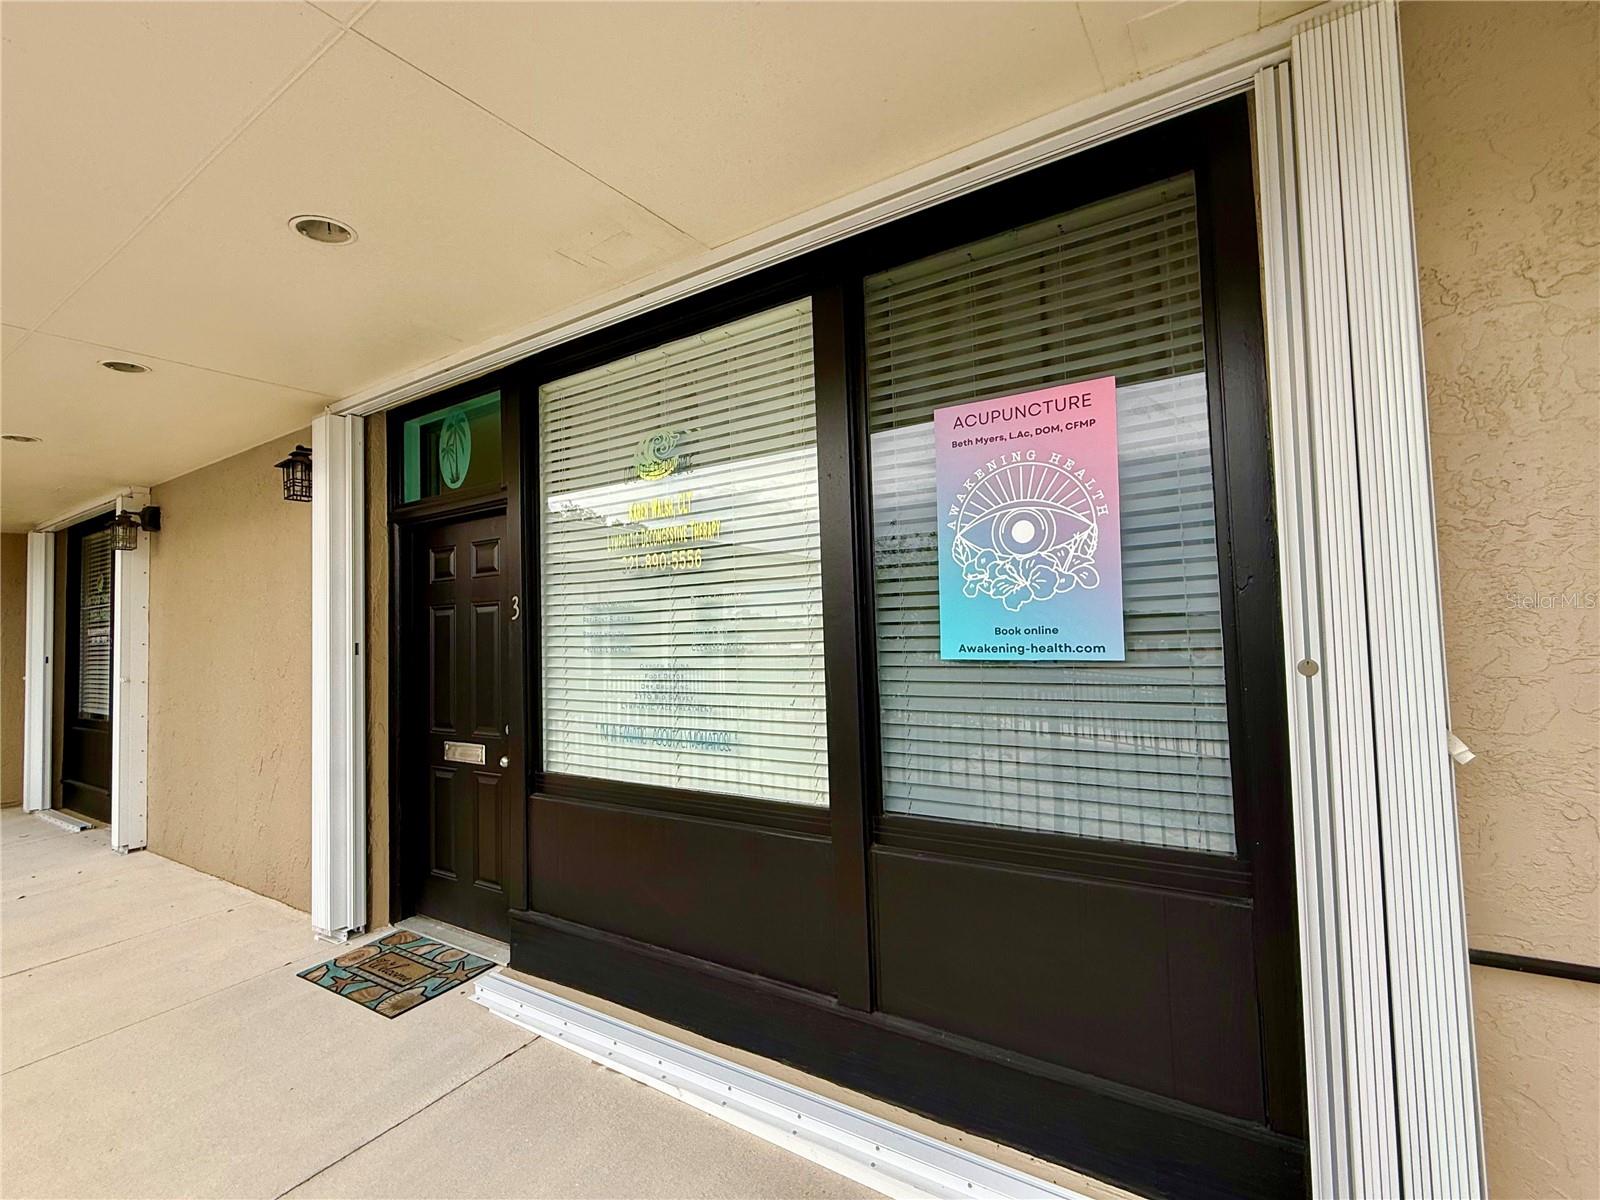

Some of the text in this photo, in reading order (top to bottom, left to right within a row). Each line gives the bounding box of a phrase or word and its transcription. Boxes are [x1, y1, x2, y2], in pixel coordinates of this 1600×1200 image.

[952, 392, 1093, 430] ACUPUNCTURE
[951, 418, 1097, 449] Beth Myers, L.Ac, DOM, CFMP
[947, 450, 1110, 530] AWAKENING HEALTH
[689, 519, 722, 542] THERAPY
[511, 595, 520, 621] 3
[994, 625, 1059, 636] Book online
[959, 642, 1106, 656] Awakening-health.com
